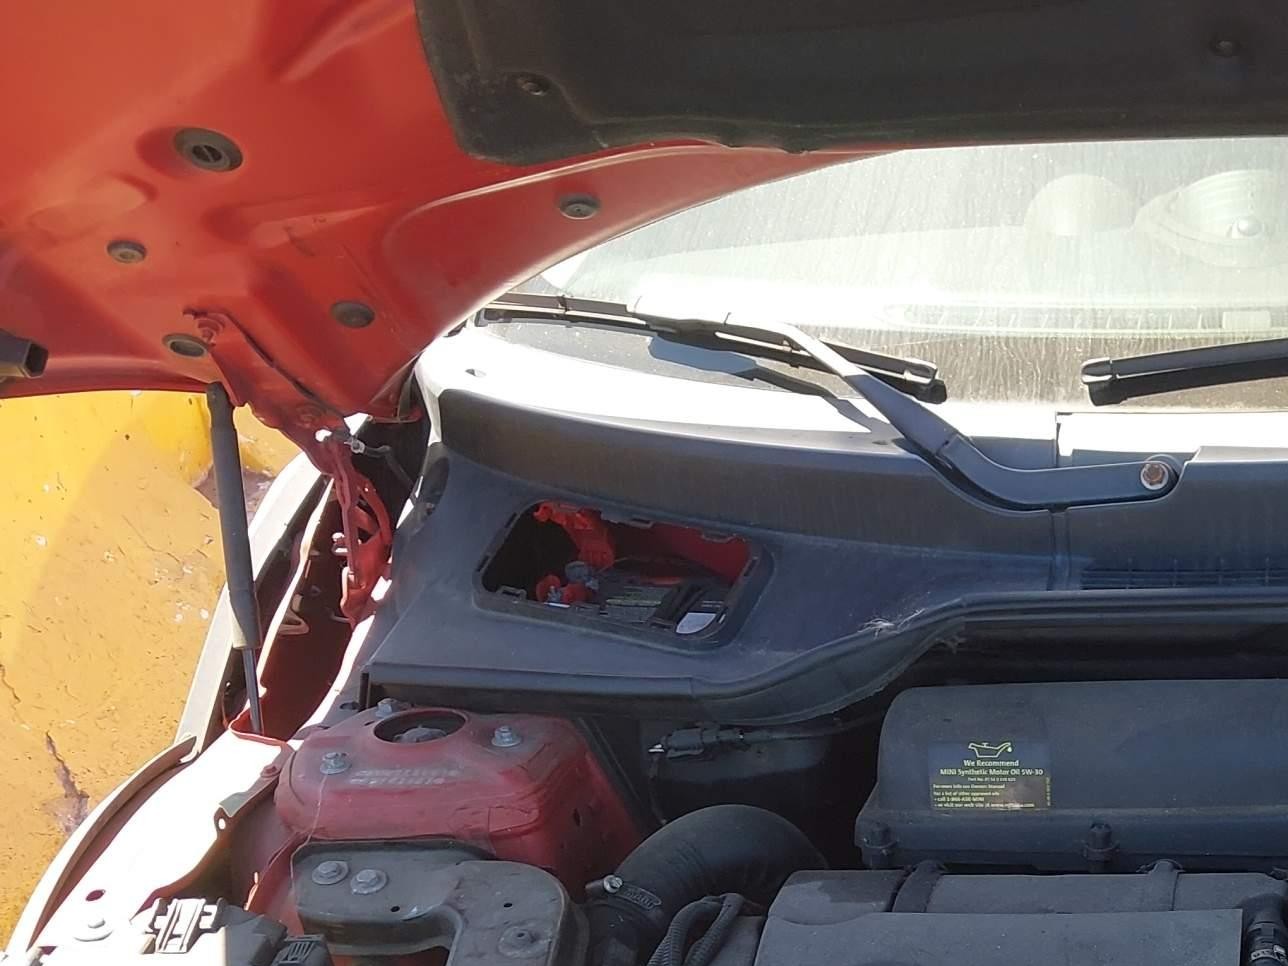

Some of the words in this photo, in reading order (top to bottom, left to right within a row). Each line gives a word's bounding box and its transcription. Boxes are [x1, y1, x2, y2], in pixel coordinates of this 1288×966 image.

[963, 759, 975, 767] We
[976, 759, 1019, 767] Recommend
[958, 768, 988, 777] Synthetic
